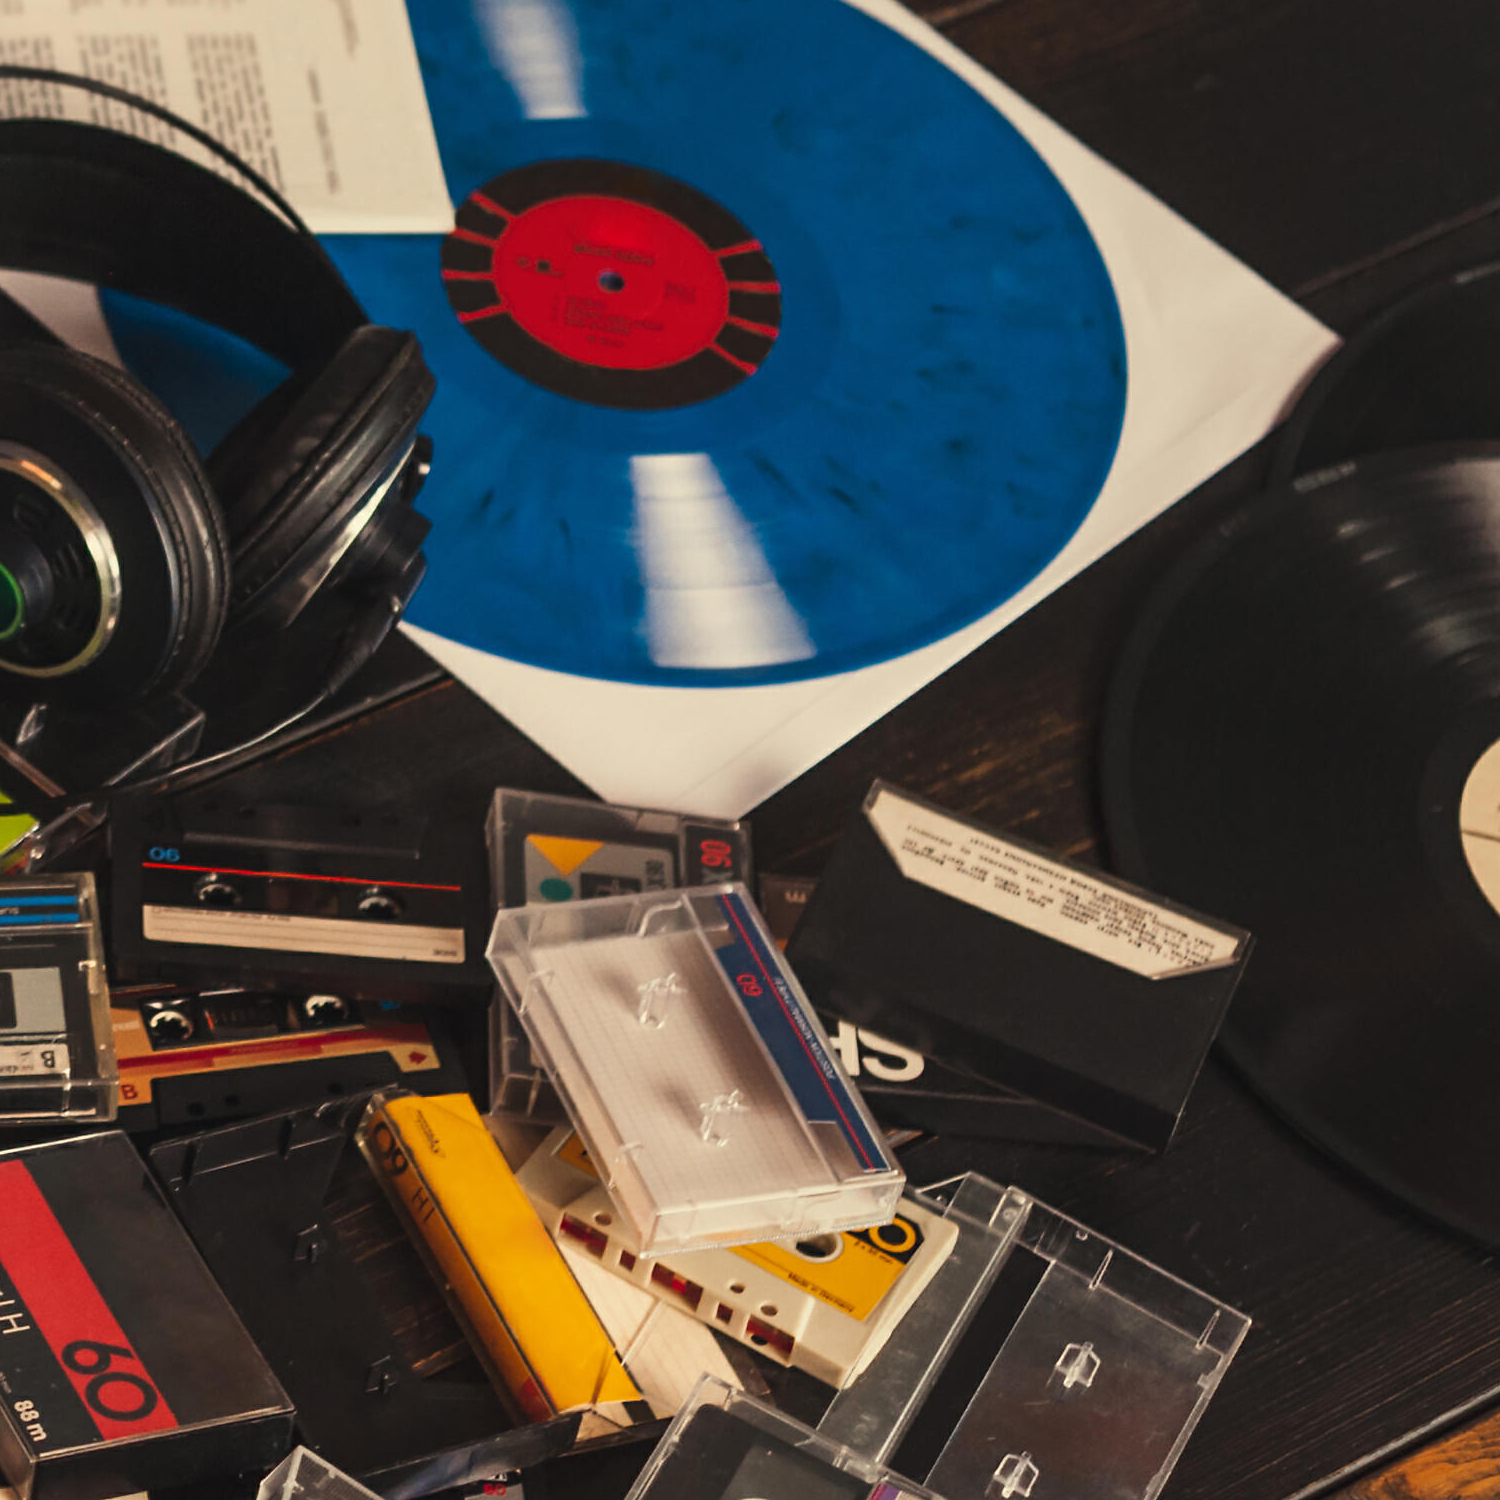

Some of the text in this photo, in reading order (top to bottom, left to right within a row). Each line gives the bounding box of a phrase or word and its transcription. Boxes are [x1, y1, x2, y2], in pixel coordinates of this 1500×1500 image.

[149, 846, 180, 863] 90
[40, 1051, 56, 1068] B
[121, 1084, 139, 1100] B
[61, 1340, 158, 1421] 60
[14, 1400, 48, 1442] 88 m
